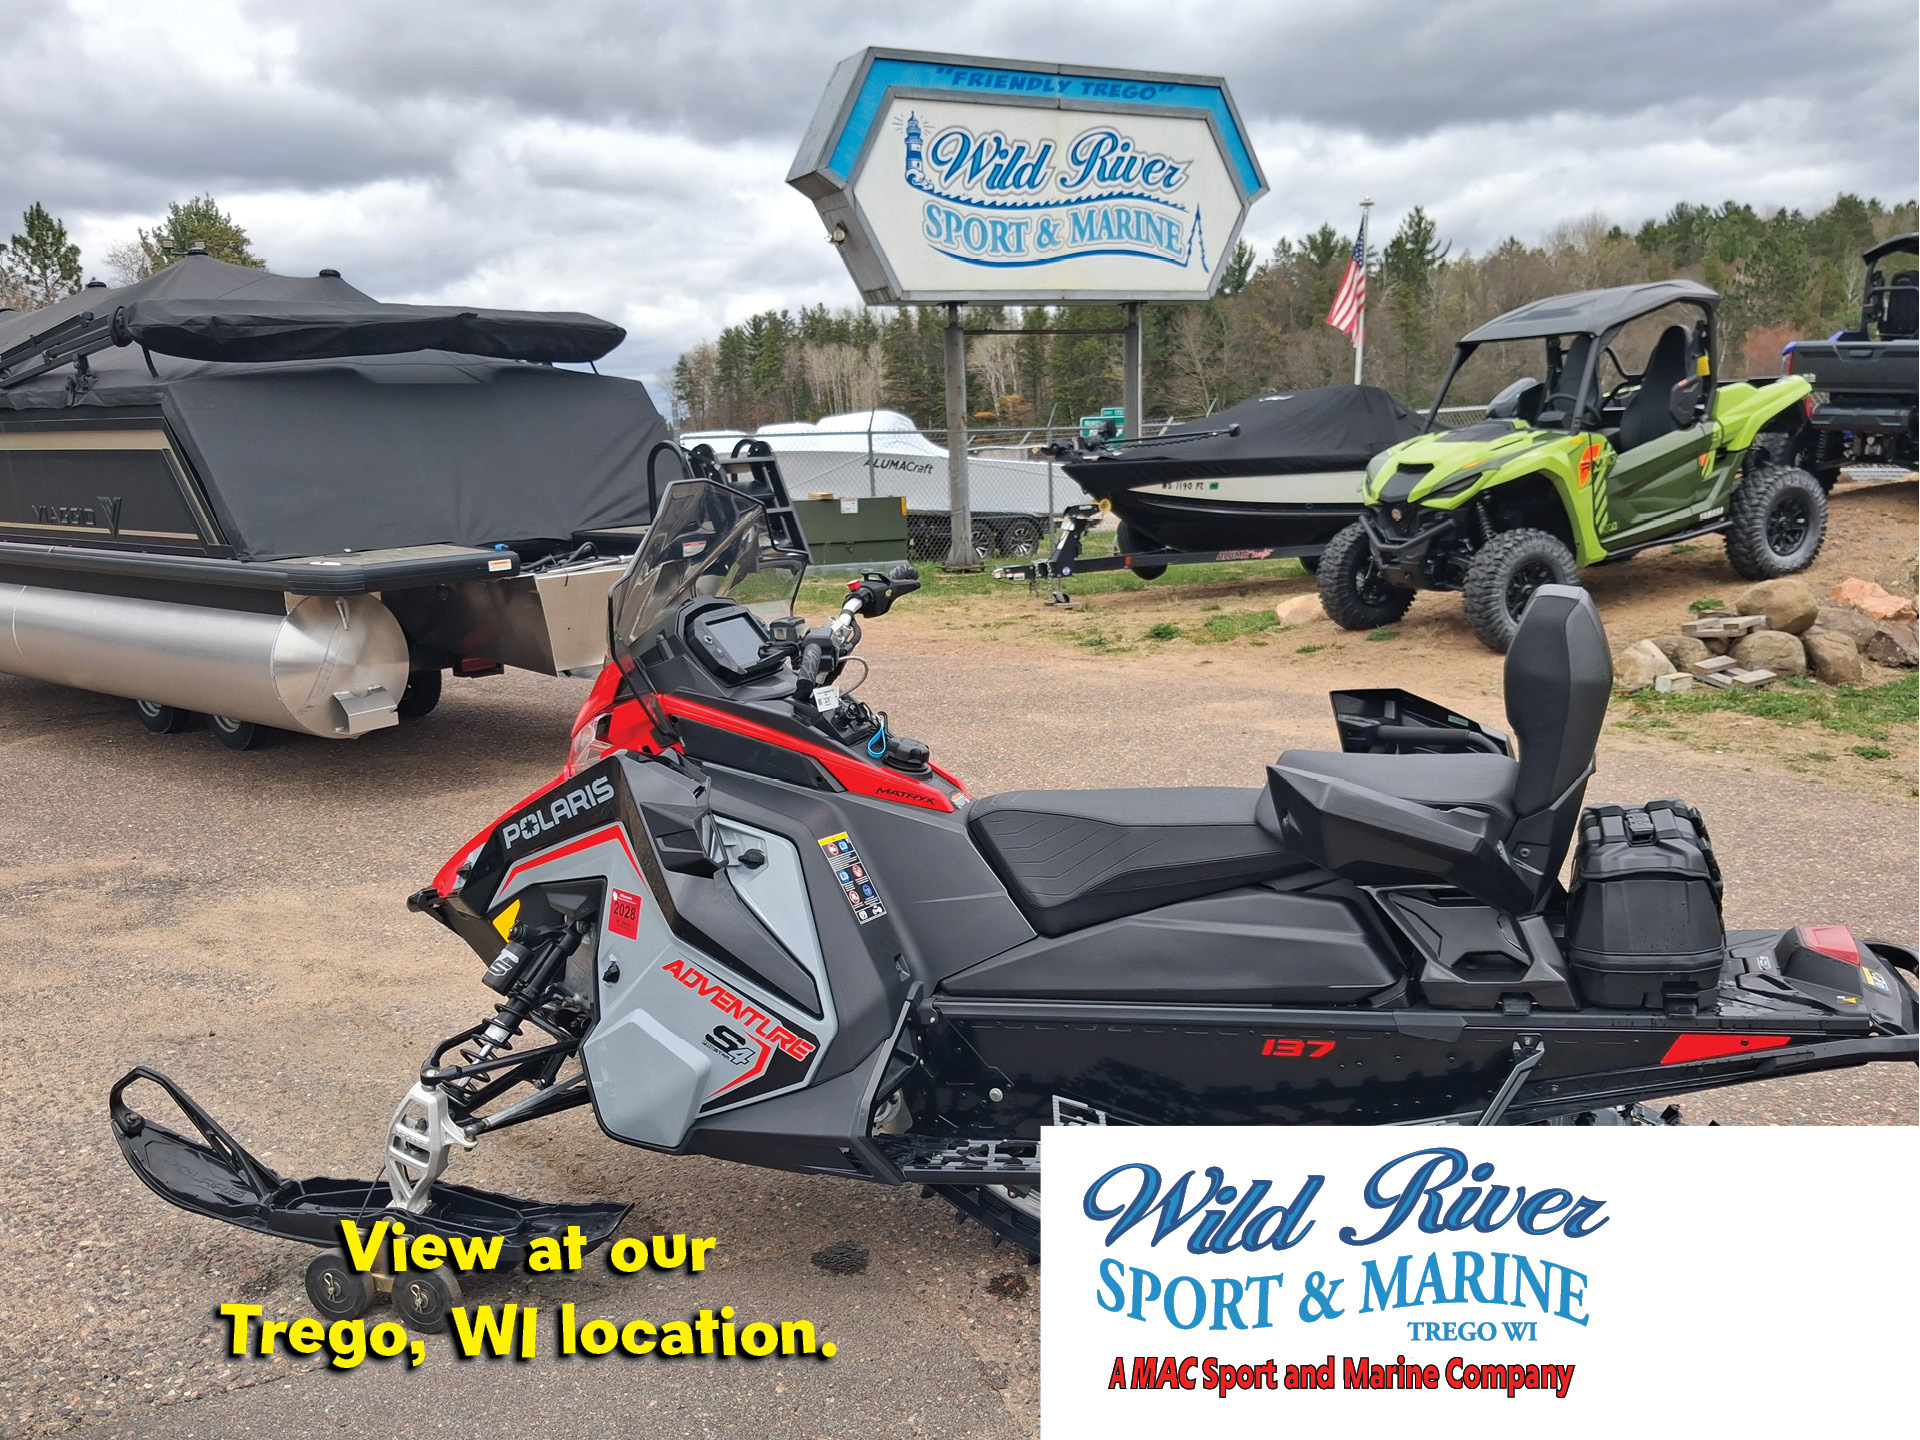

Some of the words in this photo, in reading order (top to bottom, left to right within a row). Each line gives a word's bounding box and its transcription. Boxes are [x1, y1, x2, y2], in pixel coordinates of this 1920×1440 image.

[936, 67, 1071, 94] "FRIENDLY
[1081, 81, 1174, 101] TREGO"
[930, 130, 1053, 191] Wild
[1059, 130, 1188, 189] River
[925, 203, 1030, 254] SPORT
[1035, 217, 1063, 248] &
[1068, 207, 1183, 255] MARINE
[502, 776, 615, 850] POLARIS
[875, 787, 937, 807] MATRYX
[613, 901, 636, 921] 2028
[662, 959, 816, 1062] ADVENTURE
[1261, 1039, 1336, 1058] 137
